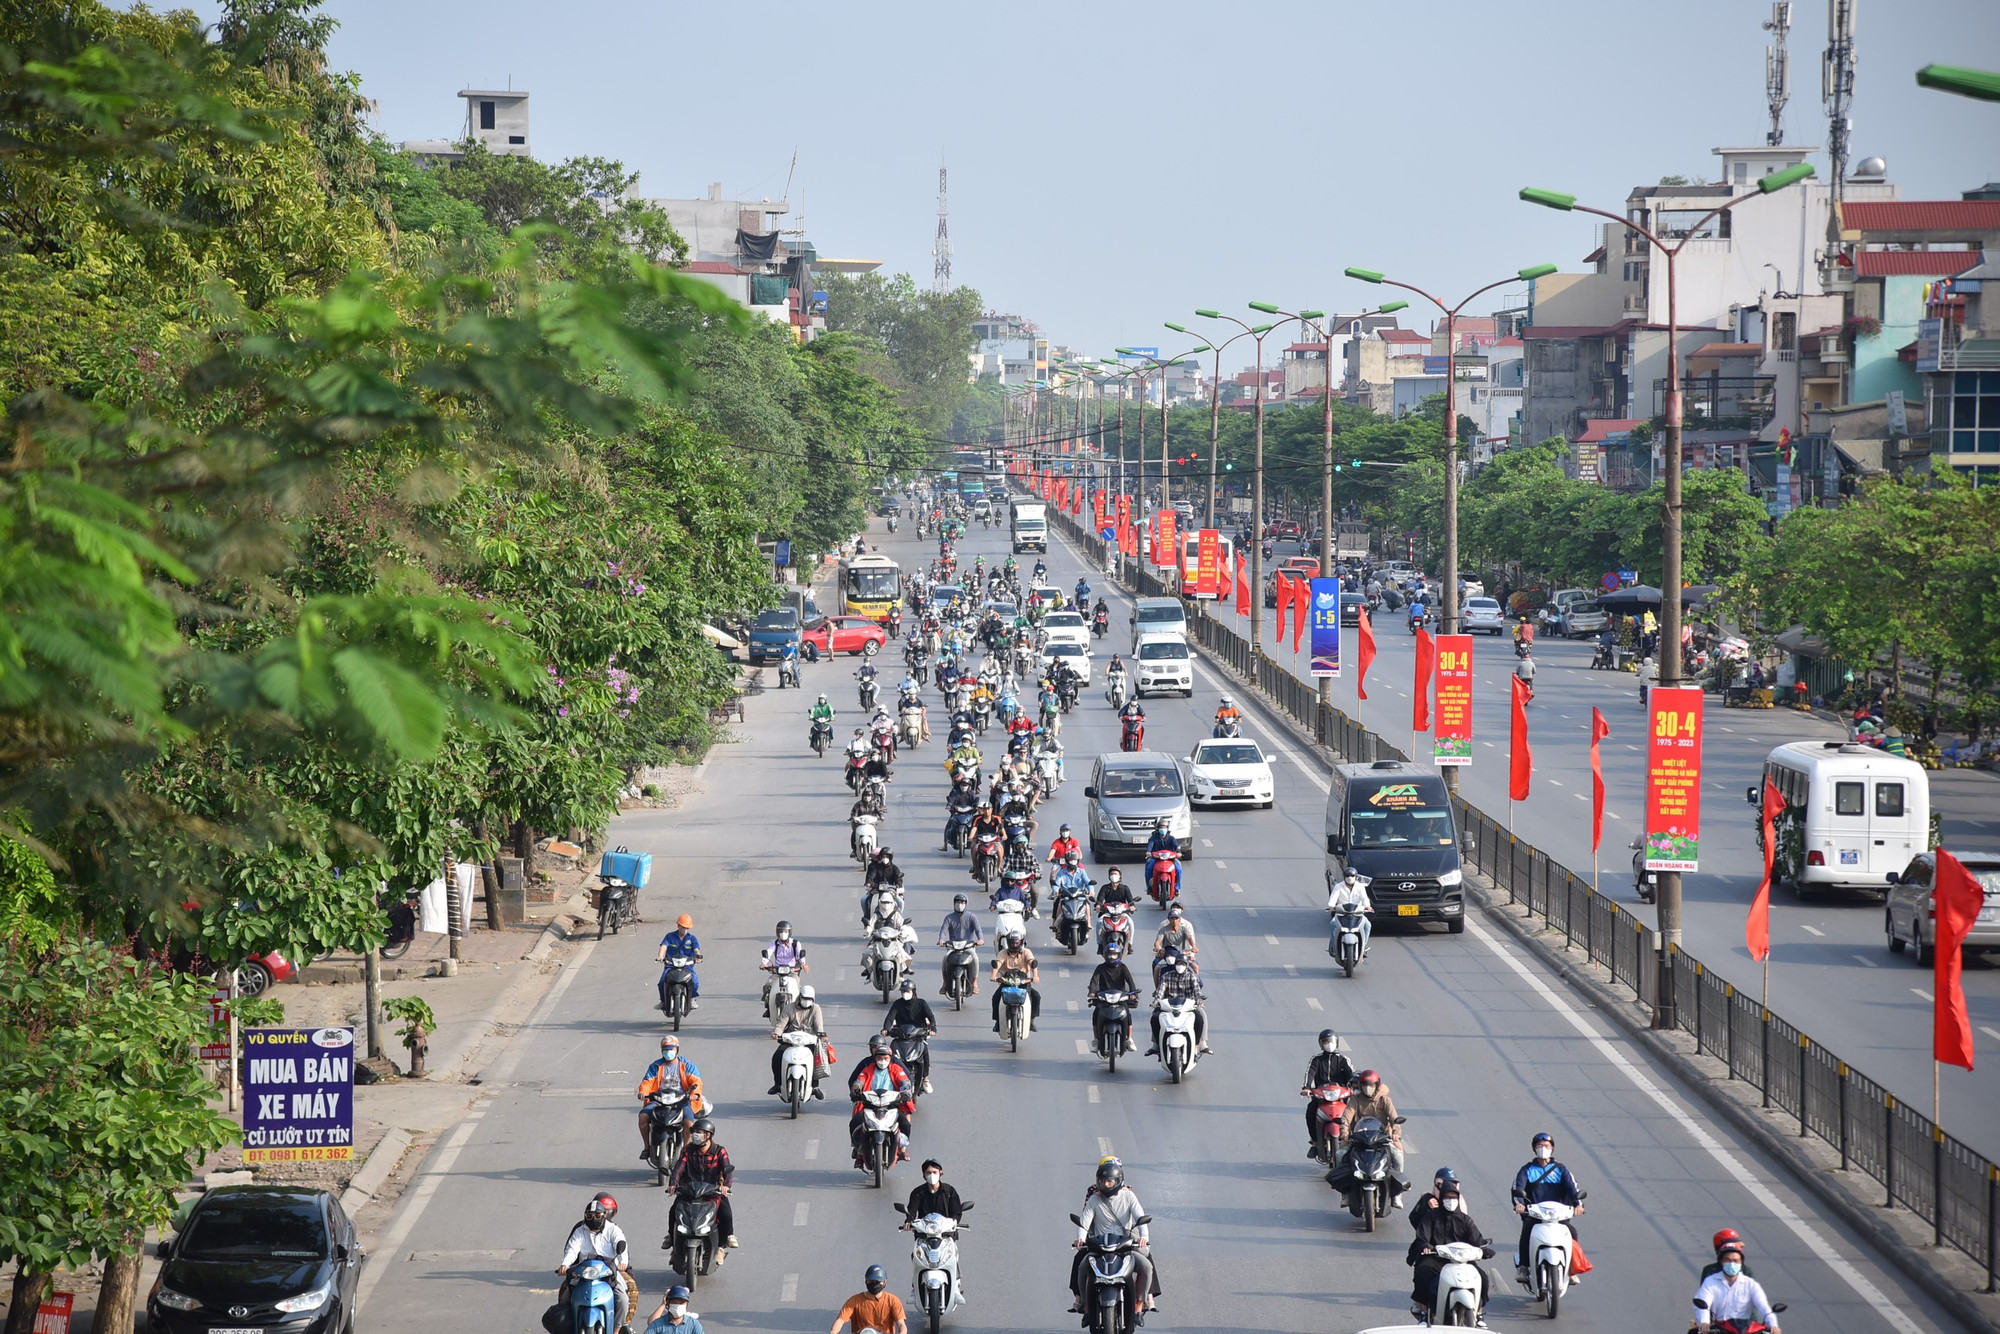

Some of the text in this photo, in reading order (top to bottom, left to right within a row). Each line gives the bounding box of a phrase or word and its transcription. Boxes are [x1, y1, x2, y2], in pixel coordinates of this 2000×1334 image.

[1315, 610, 1336, 624] 1-5
[1657, 738, 1672, 746] 1975
[1678, 739, 1694, 747] 2023
[248, 1030, 308, 1044] VŨ QUYỀN
[250, 1053, 348, 1084] MUA BÁN
[258, 1088, 340, 1120] XE MÁY
[248, 1124, 350, 1145] CŨ LƯỚT UY TÍN
[249, 1148, 348, 1161] ĐT: 0981 612 362
